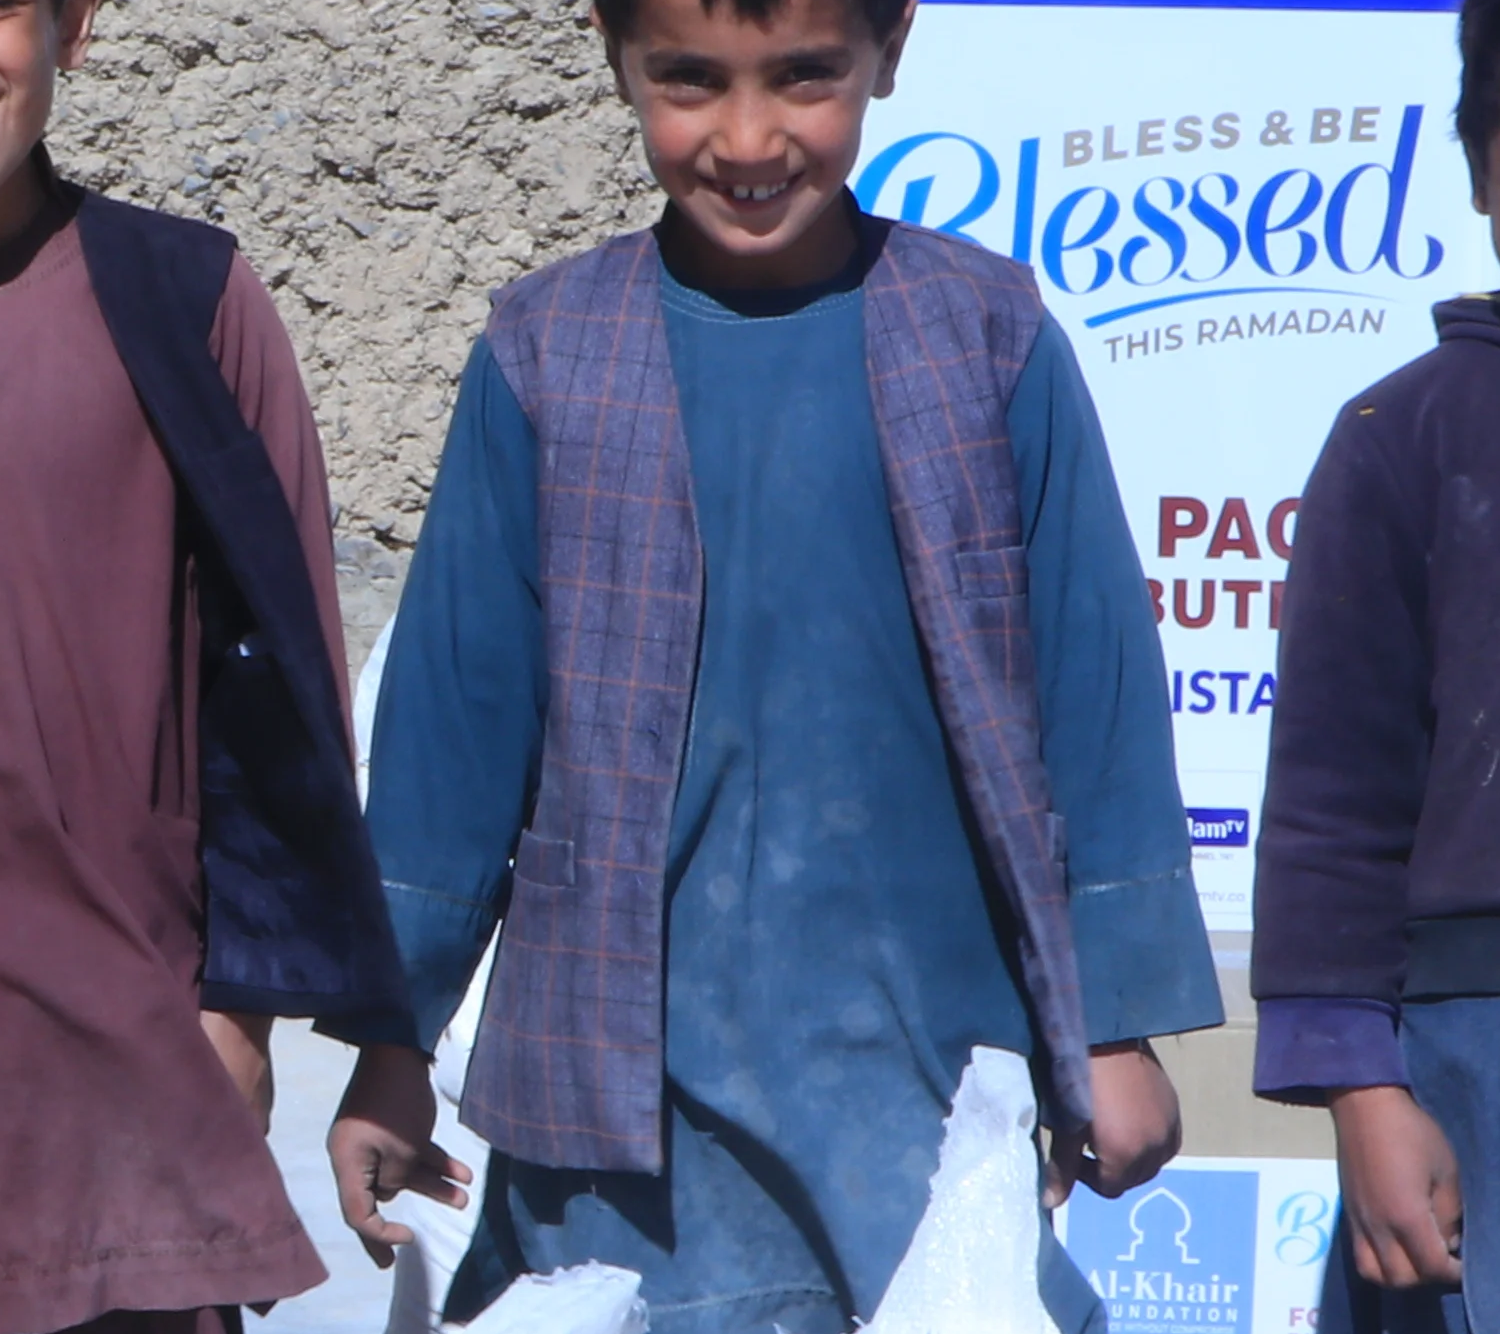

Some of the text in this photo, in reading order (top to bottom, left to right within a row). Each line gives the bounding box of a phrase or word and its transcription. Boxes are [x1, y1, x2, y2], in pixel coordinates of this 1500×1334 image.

[1062, 106, 1381, 168] BLESS & BE
[853, 104, 1444, 295] Blessed
[1104, 308, 1386, 363] THIS RAMADAN
[1158, 496, 1301, 561] PAC
[1112, 1304, 1238, 1323] UNDATION
